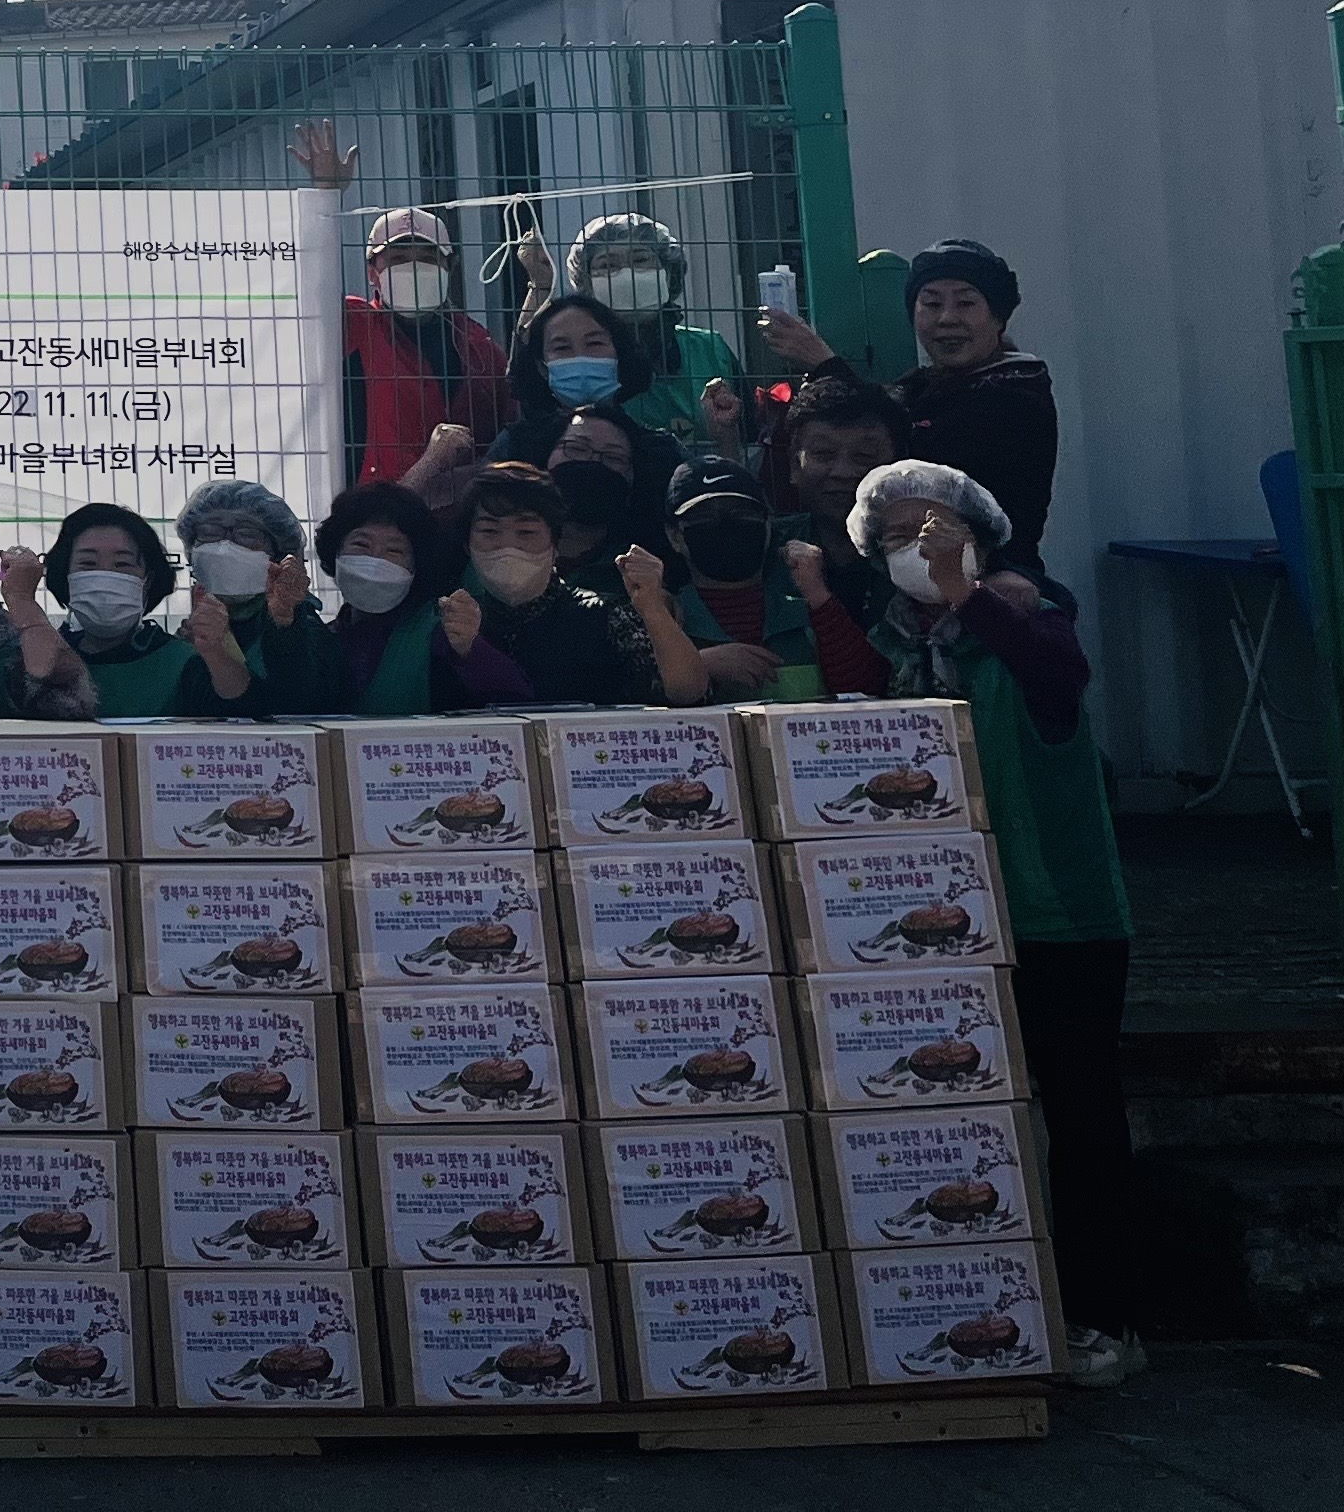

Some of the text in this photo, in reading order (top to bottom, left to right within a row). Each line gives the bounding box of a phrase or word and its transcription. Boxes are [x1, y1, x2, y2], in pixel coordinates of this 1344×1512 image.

[123, 240, 297, 263] 해양수산부지원사업
[148, 443, 236, 475] 사무실
[610, 747, 678, 764] 고잔동새마을회
[414, 889, 483, 906] 고잔동새마을회
[426, 1024, 497, 1041] 고잔동새마을회
[190, 1034, 259, 1051] 고잔동새마을회
[215, 1171, 285, 1188] 고잔동새마을회
[438, 1172, 509, 1189] 고잔동새마을회
[228, 1310, 299, 1326] 고잔동새마을회
[464, 1307, 536, 1324] 고잔동새마을회
